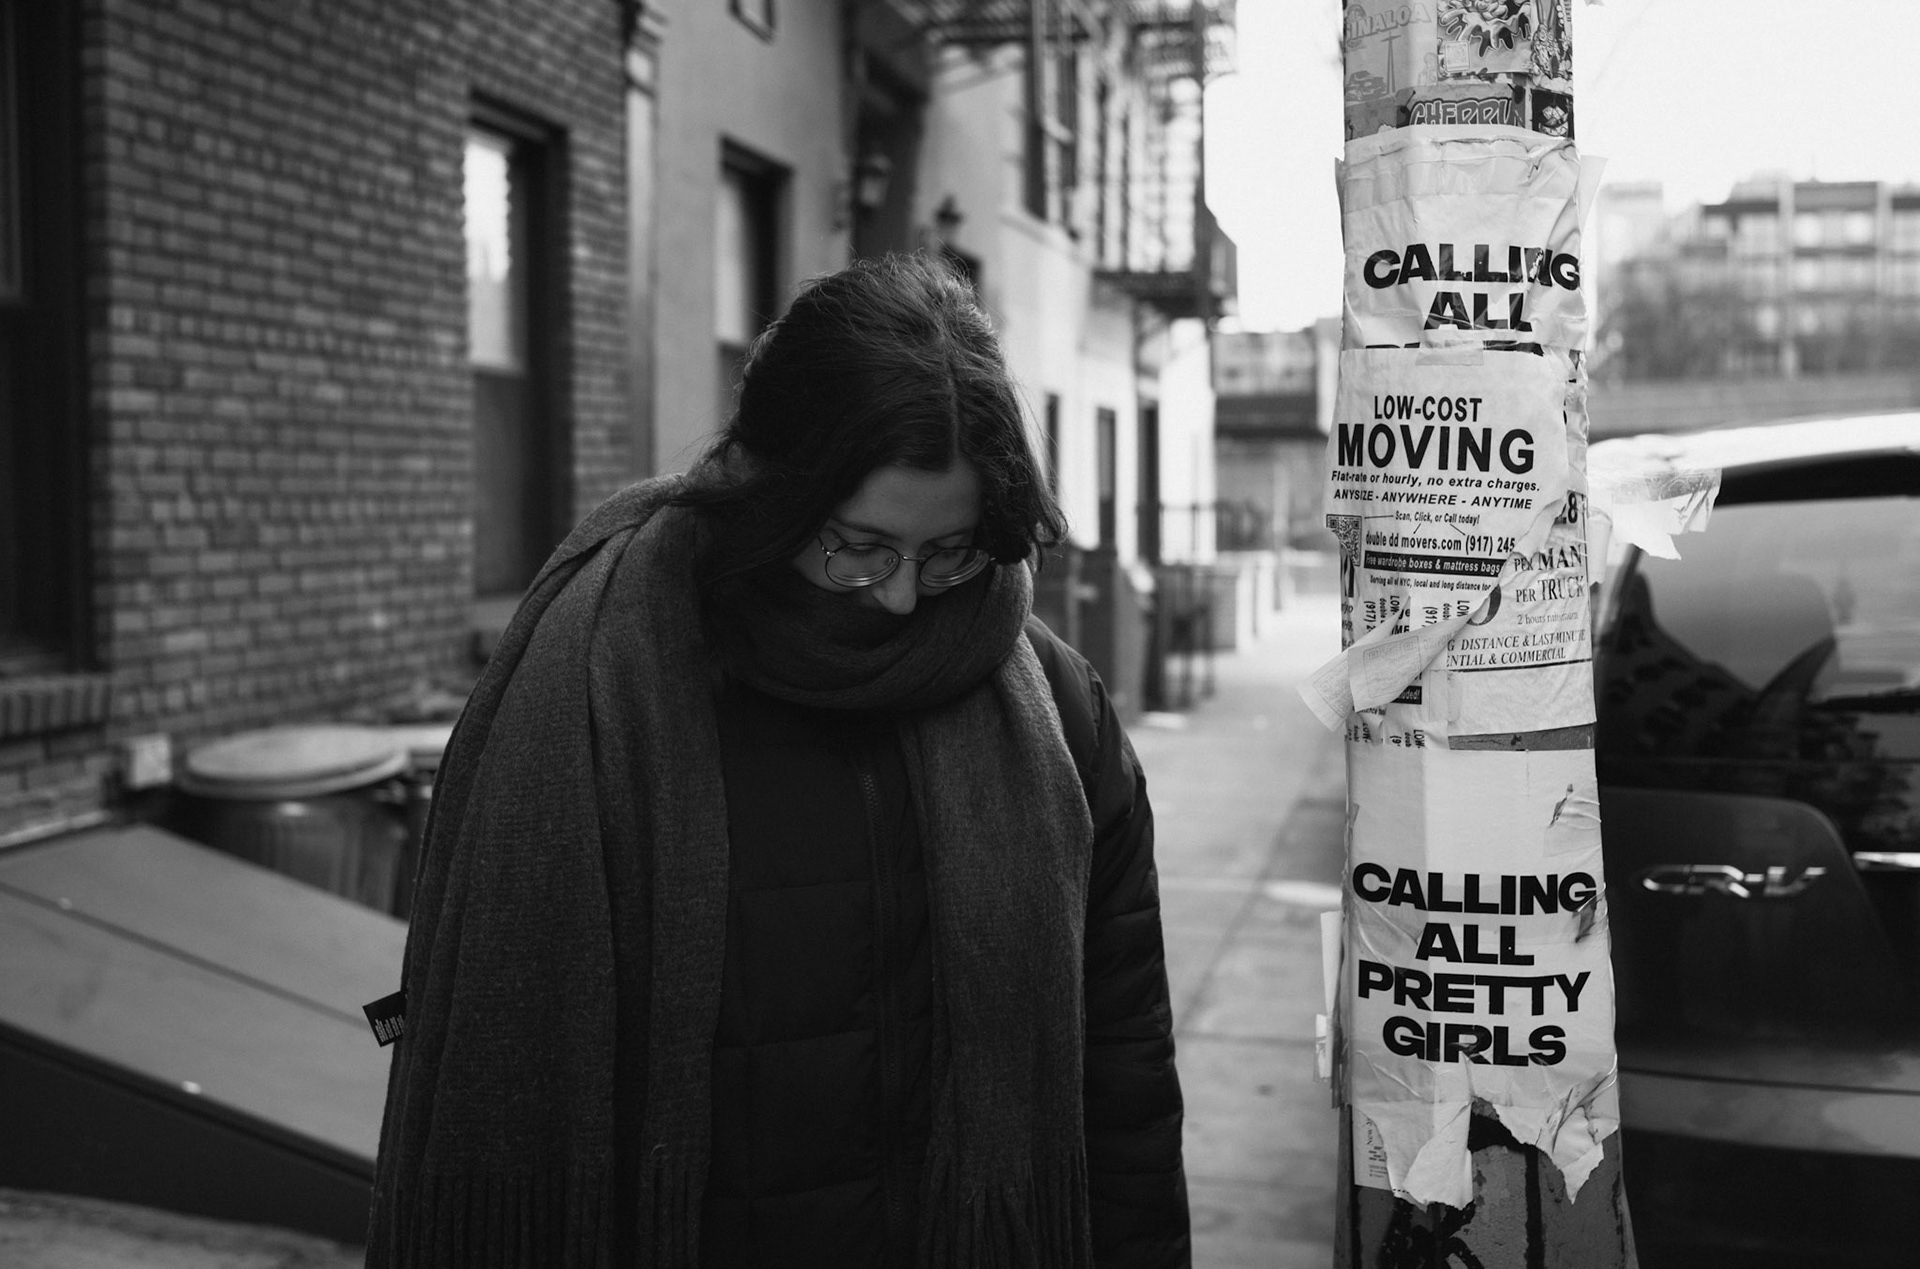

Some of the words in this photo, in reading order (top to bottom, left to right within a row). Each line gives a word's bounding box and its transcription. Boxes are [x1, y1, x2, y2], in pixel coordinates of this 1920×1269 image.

[1364, 243, 1580, 290] CALLING
[1424, 292, 1532, 332] ALL
[1374, 395, 1482, 422] LOW-COST
[1338, 423, 1534, 474] MOVING
[1331, 471, 1367, 483] Flat-rate
[1370, 474, 1380, 483] or
[1382, 473, 1422, 487] hourly,
[1427, 477, 1443, 486] no
[1449, 477, 1482, 488] extra
[1487, 478, 1540, 492] charges.
[1381, 491, 1457, 505] ANYWHERE
[1471, 496, 1533, 509] ANYTIME
[1435, 514, 1442, 522] or
[1444, 512, 1457, 524] Call
[1366, 530, 1386, 546] double
[1389, 532, 1399, 547] dd
[1401, 536, 1461, 550] movers.com
[1465, 535, 1493, 556] (917)
[1409, 557, 1433, 569] boxes
[1435, 558, 1441, 570] &
[1443, 561, 1479, 572] mattress
[1481, 561, 1500, 575] bags
[1538, 544, 1583, 570] MAN
[1429, 579, 1440, 588] and
[1456, 581, 1480, 590] distance
[1515, 588, 1536, 602] PER
[1538, 576, 1584, 601] TRUCK
[1517, 614, 1523, 625] 2
[1525, 613, 1545, 624] hours
[1461, 635, 1519, 650] DISTANCE
[1522, 635, 1529, 647] &
[1488, 653, 1497, 664] &
[1501, 648, 1566, 665] COMMERCIAL
[1352, 862, 1597, 916] CALLING
[1416, 922, 1534, 966] ALL
[1358, 959, 1591, 1017] PRETTY
[1383, 1016, 1566, 1067] GIRLS
